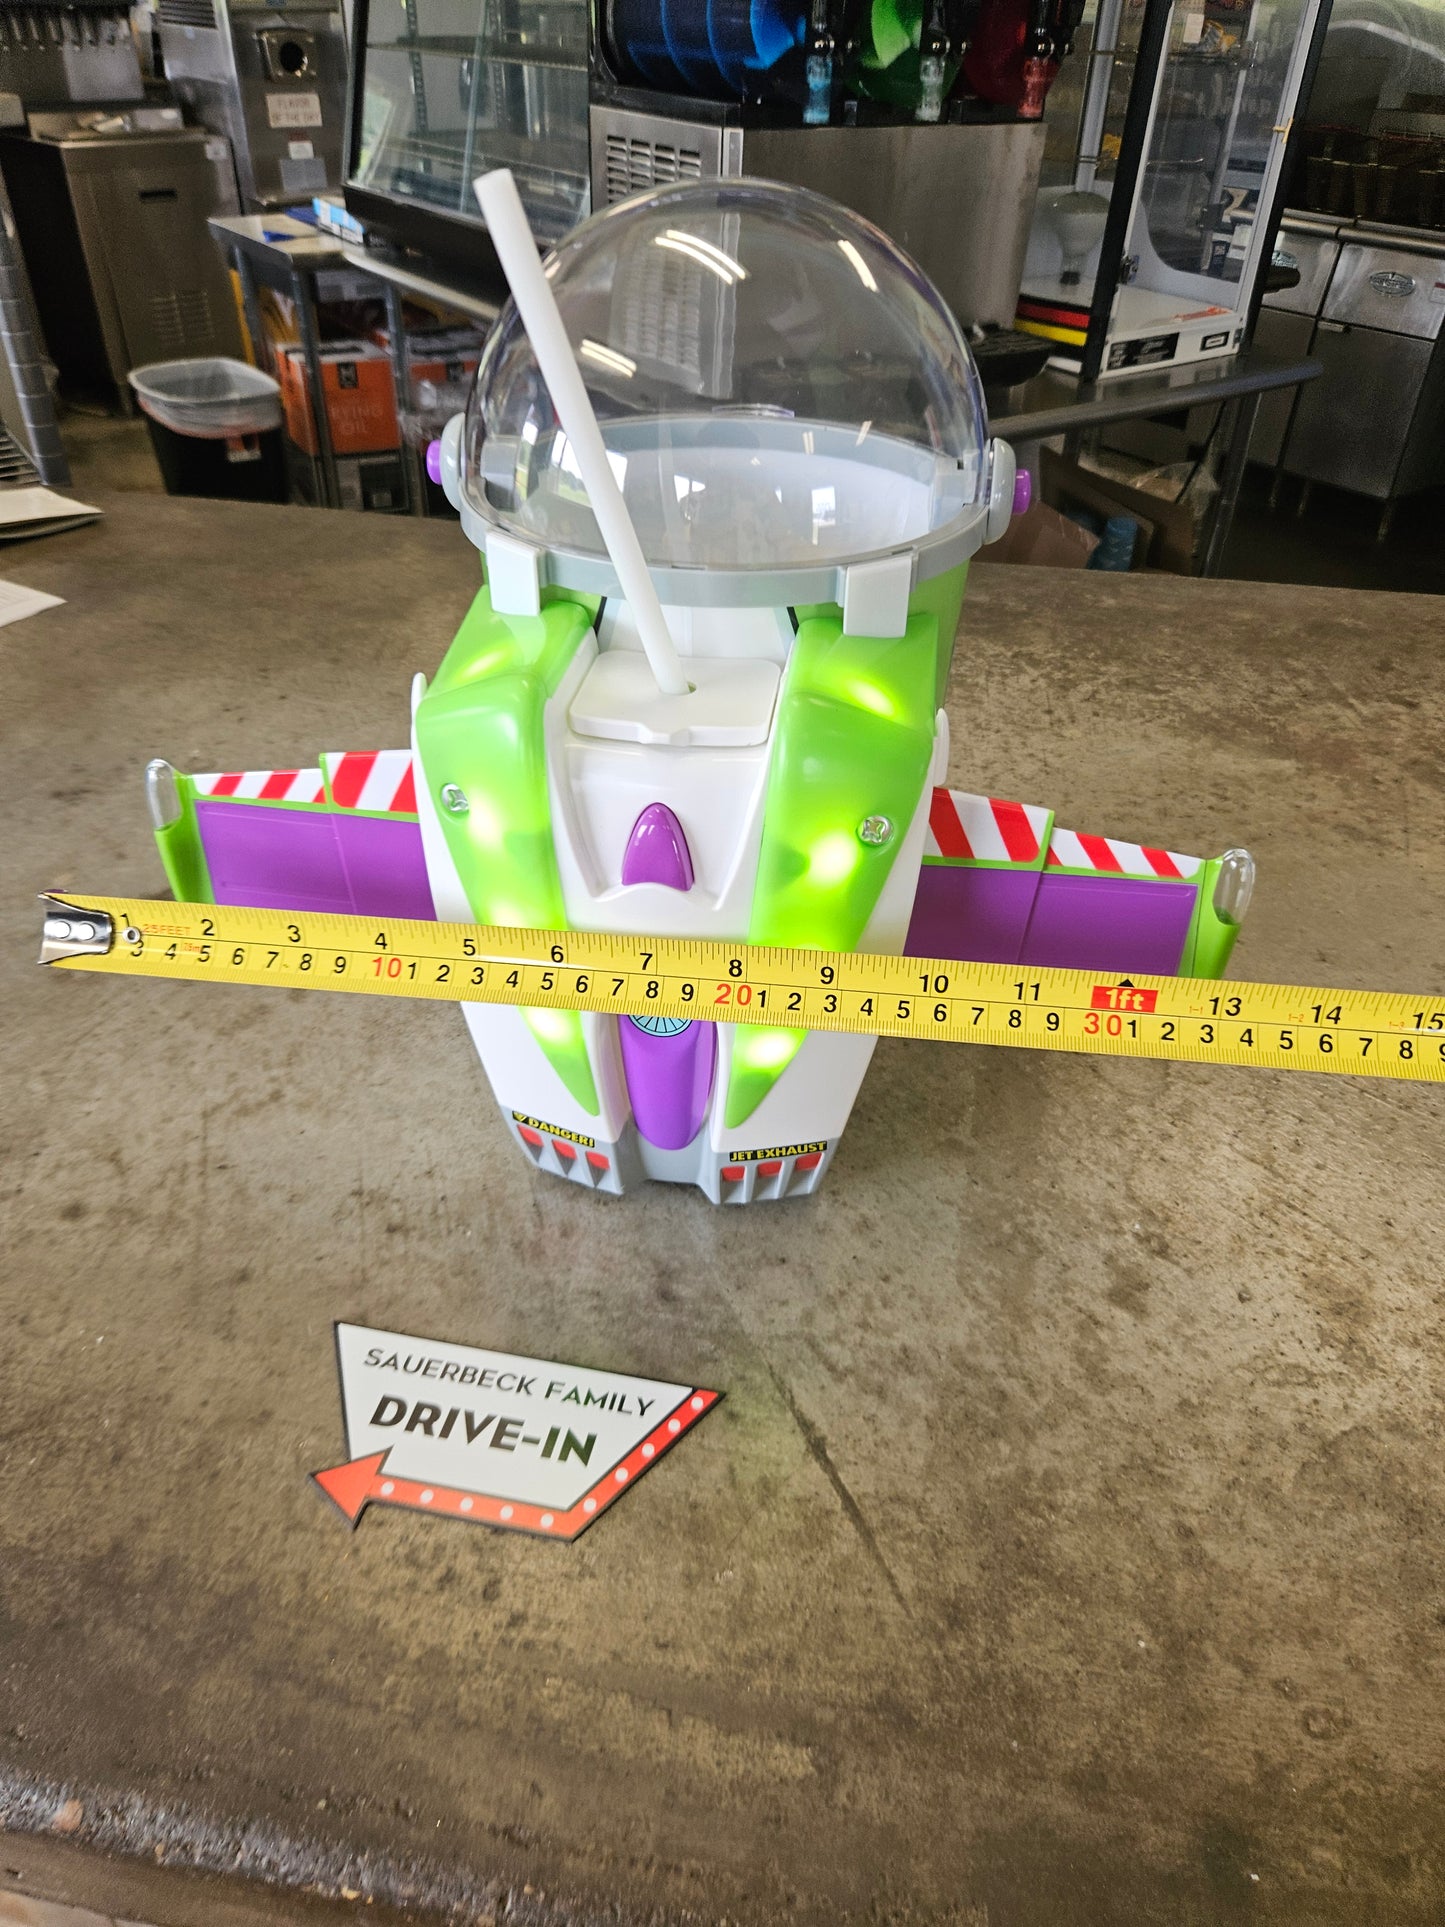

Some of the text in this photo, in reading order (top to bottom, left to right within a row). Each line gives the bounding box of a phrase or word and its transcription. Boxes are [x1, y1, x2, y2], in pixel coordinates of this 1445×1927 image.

[164, 943, 177, 960] 4
[197, 945, 211, 962] 5
[231, 947, 246, 966] 6
[266, 951, 280, 969] 7
[299, 953, 313, 971] 8
[333, 956, 347, 975] 9
[373, 957, 402, 978] 10
[407, 962, 417, 980] 1
[435, 964, 450, 983] 2
[470, 966, 485, 986] 3
[505, 970, 519, 989] 4
[540, 972, 554, 991] 5
[575, 974, 589, 994] 6
[611, 978, 625, 997] 7
[645, 980, 659, 999] 8
[681, 983, 695, 1003] 9
[715, 983, 752, 1006] 20
[756, 989, 767, 1009] 1
[787, 992, 802, 1012] 2
[823, 994, 838, 1014] 3
[860, 998, 874, 1017] 4
[896, 1000, 911, 1020] 5
[933, 1003, 947, 1023] 6
[971, 1006, 985, 1026] 7
[1008, 1009, 1022, 1029] 8
[1046, 1012, 1060, 1032] 9
[1084, 1014, 1123, 1036] 30
[1127, 1019, 1138, 1039] 1
[1160, 1021, 1175, 1042] 2
[1200, 1024, 1214, 1044] 3
[1239, 1028, 1254, 1048] 4
[1279, 1030, 1294, 1050] 5
[1319, 1033, 1334, 1054] 6
[1358, 1037, 1373, 1057] 7
[1399, 1039, 1414, 1060] 8
[200, 917, 216, 937] 2
[287, 924, 301, 943] 3
[374, 932, 388, 950] 4
[463, 938, 476, 957] 5
[550, 944, 564, 964] 6
[639, 952, 653, 971] 7
[728, 958, 743, 978] 8
[820, 965, 835, 985] 9
[918, 974, 949, 994] 10
[1013, 981, 1041, 1001] 11
[1105, 988, 1145, 1012] 1ft
[1209, 996, 1242, 1017] 13
[1311, 1004, 1342, 1025] 14
[1412, 1012, 1445, 1032] 15
[528, 1117, 595, 1147] DANGER!
[730, 1142, 827, 1161] JET EXHAUST
[364, 1348, 655, 1417] SAUERBECK FAMILY
[369, 1394, 598, 1467] DRIVE-IN
